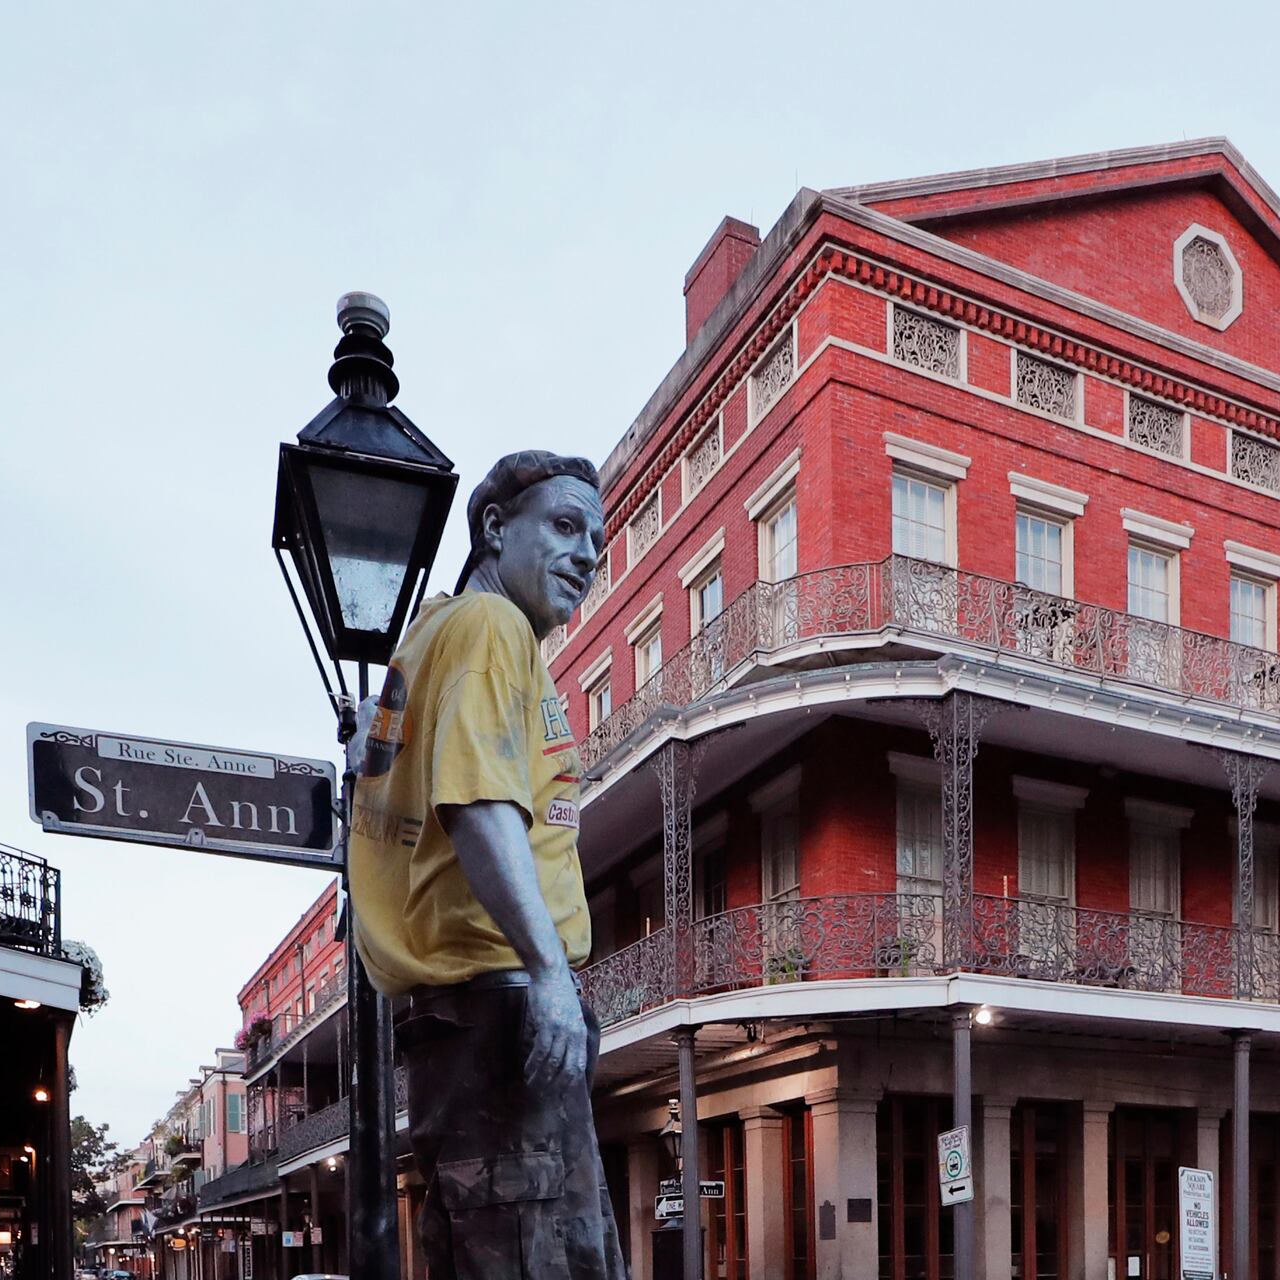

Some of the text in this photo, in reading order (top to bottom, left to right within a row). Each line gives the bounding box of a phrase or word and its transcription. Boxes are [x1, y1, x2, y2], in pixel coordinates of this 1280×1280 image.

[117, 741, 258, 775] Rue Ste. Anne
[72, 765, 149, 819] St.
[178, 780, 300, 836] Ann
[1186, 1209, 1209, 1220] VEHICLES
[1186, 1219, 1209, 1229] ALLOWED
